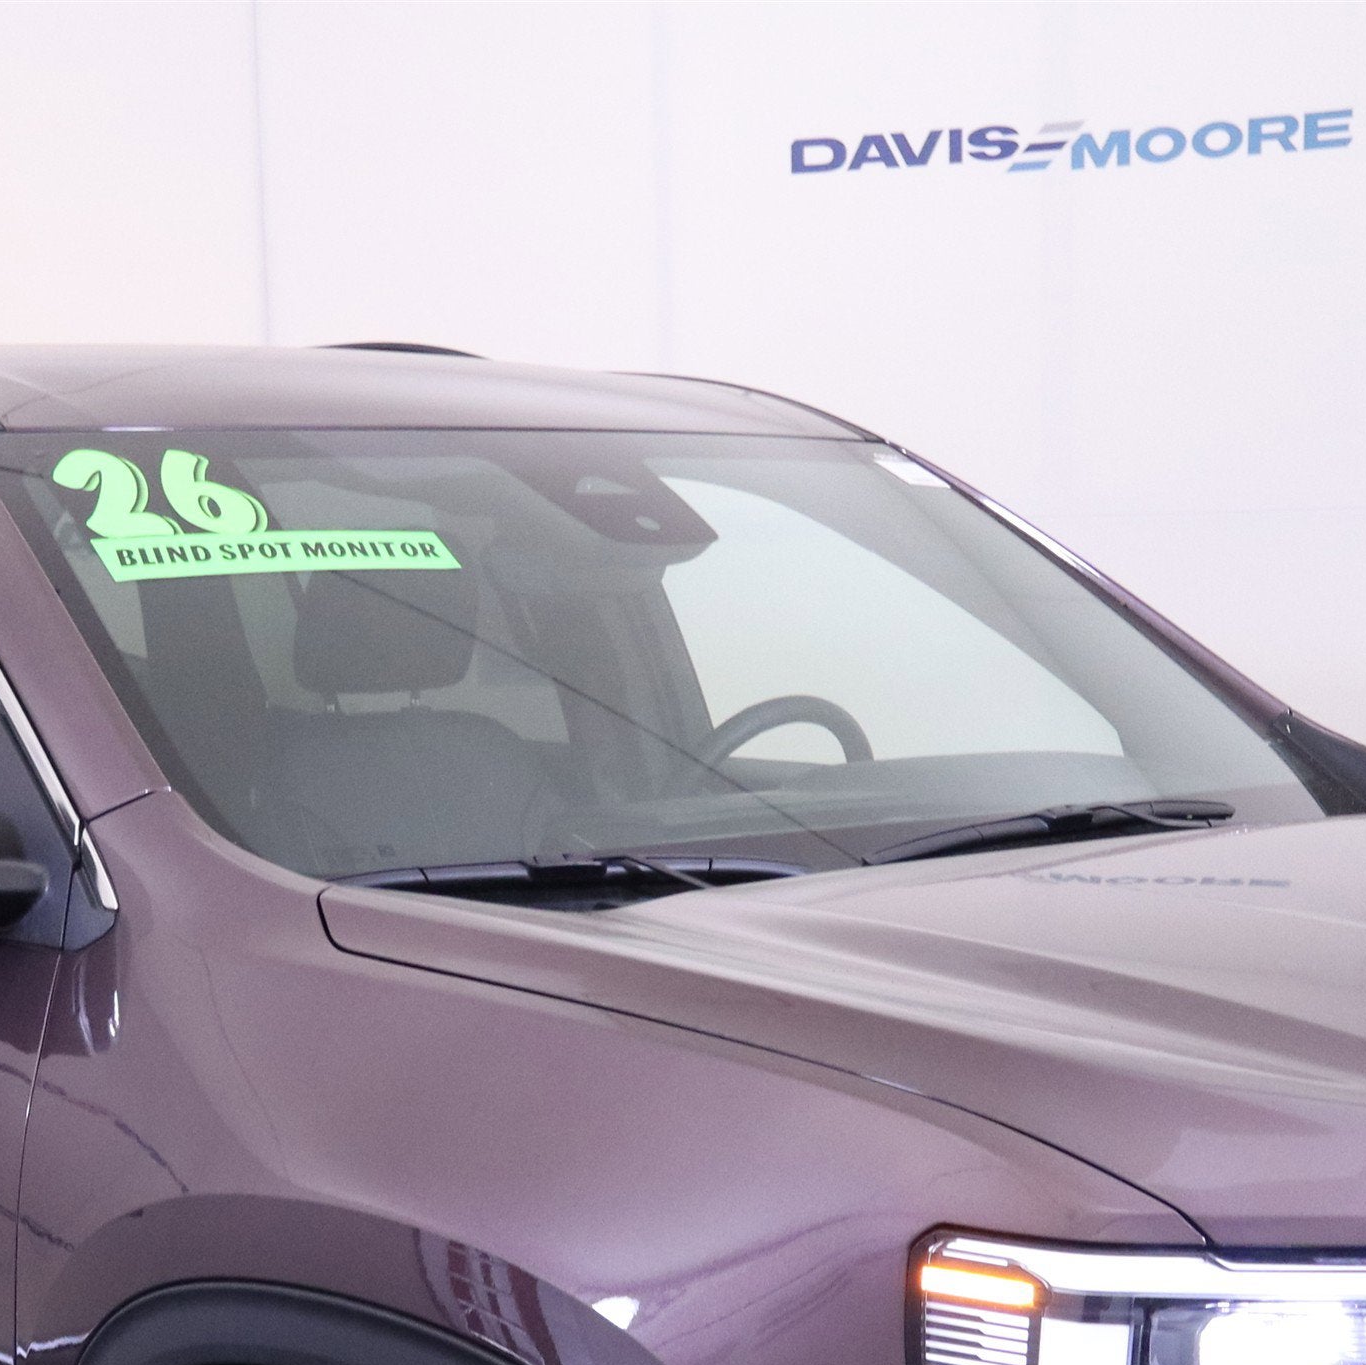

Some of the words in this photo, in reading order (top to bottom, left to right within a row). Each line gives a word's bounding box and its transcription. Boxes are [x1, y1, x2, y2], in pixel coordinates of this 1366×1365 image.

[790, 125, 1022, 174] DAVIS
[1069, 108, 1354, 170] MOORE
[51, 448, 269, 538] 26
[115, 543, 212, 568] BLIND
[221, 541, 293, 561] SPOT
[300, 540, 442, 559] MONITOR
